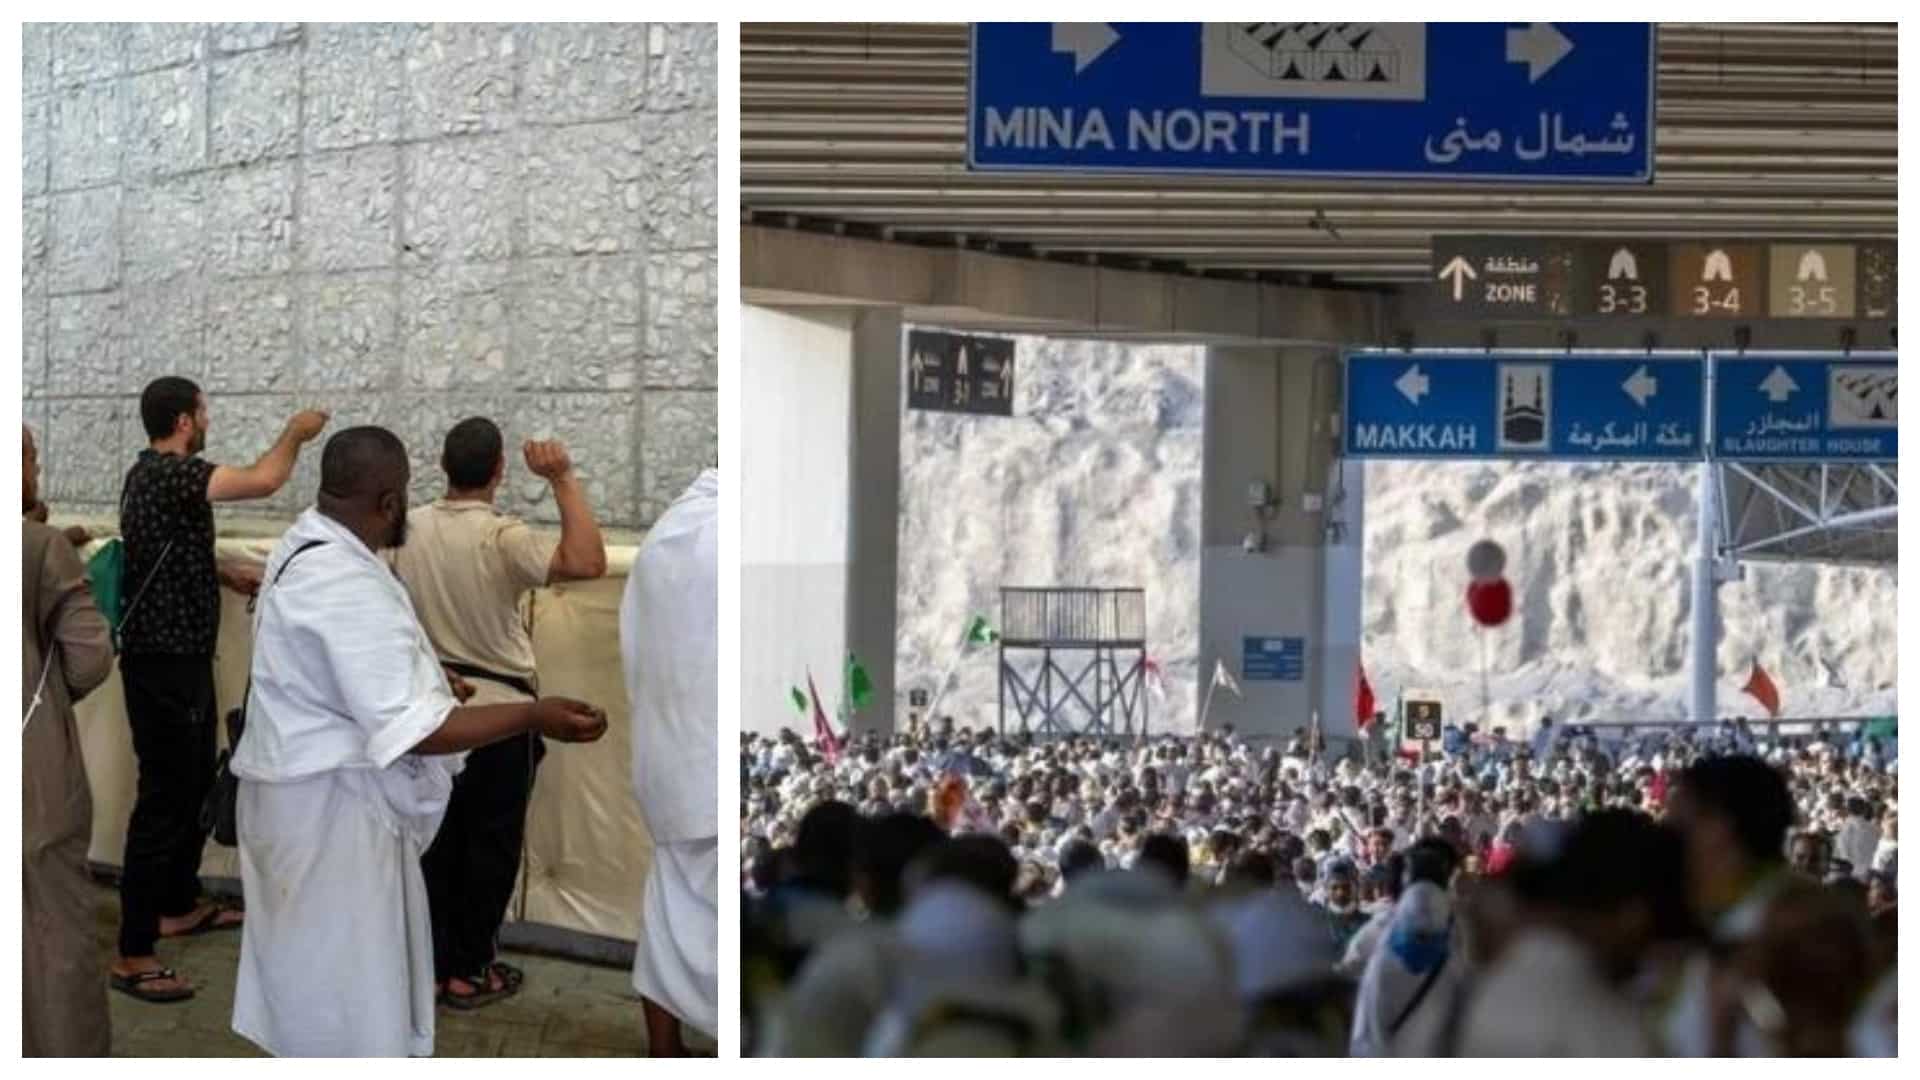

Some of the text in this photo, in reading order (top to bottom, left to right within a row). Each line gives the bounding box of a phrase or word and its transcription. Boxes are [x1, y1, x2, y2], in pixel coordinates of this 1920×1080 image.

[984, 106, 1309, 154] MINA NORTH
[1424, 111, 1634, 163] شمال منى
[1485, 256, 1539, 273] منطقة
[1485, 284, 1537, 303] ZONE
[1599, 285, 1648, 314] 3-3
[1693, 285, 1741, 315] 3-4
[1790, 286, 1837, 314] 3-5
[1356, 423, 1477, 449] MAKKAH
[1568, 421, 1692, 451] مكة المكرمة
[1828, 437, 1882, 453] HOUSE
